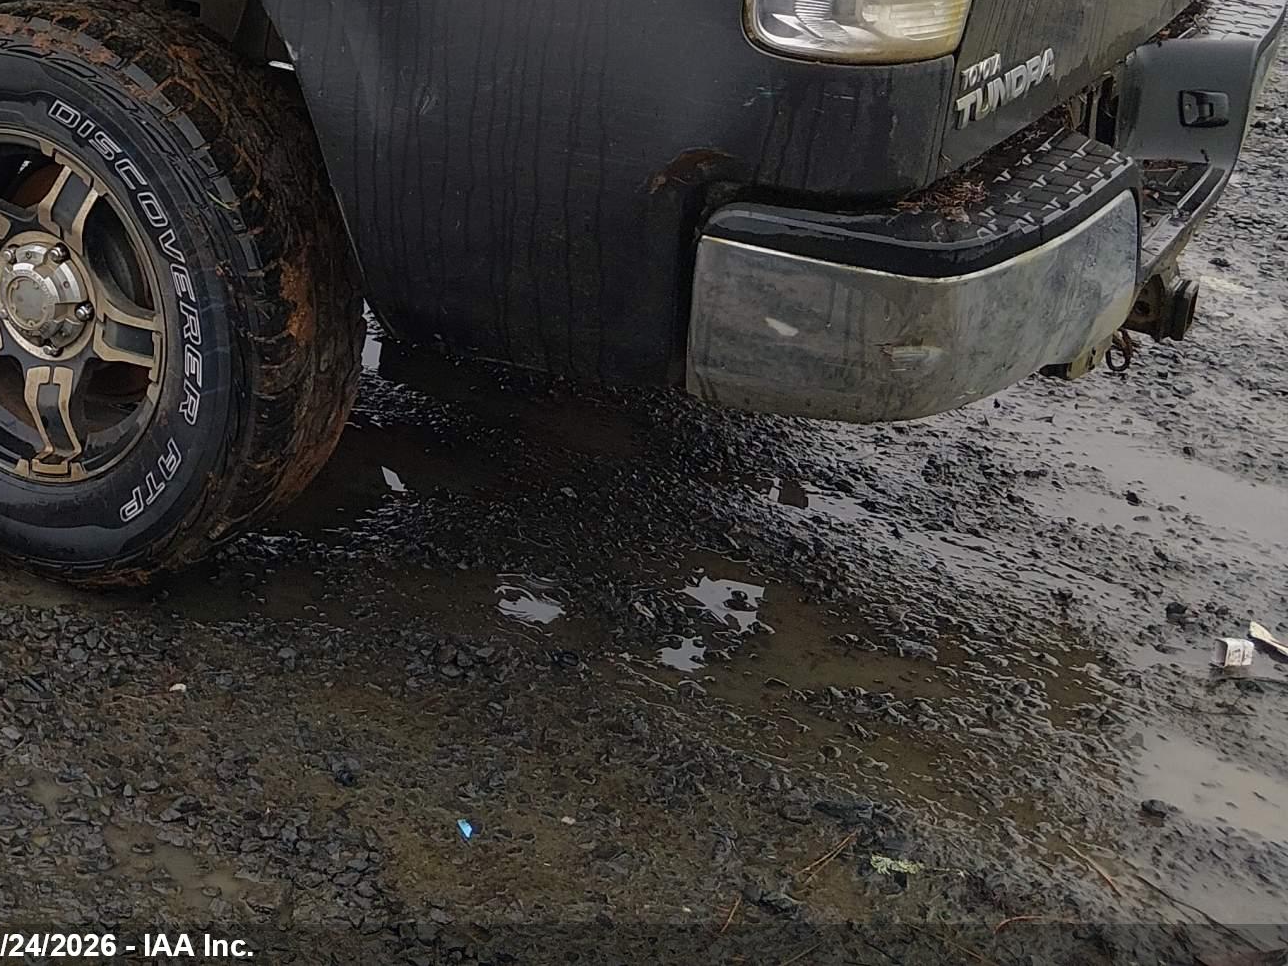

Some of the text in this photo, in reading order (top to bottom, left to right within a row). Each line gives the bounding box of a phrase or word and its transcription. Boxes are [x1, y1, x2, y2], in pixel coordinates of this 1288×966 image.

[955, 47, 1055, 130] TUNDRA
[961, 53, 1001, 91] TOYOTA
[47, 98, 203, 522] DISCOVERER ATP
